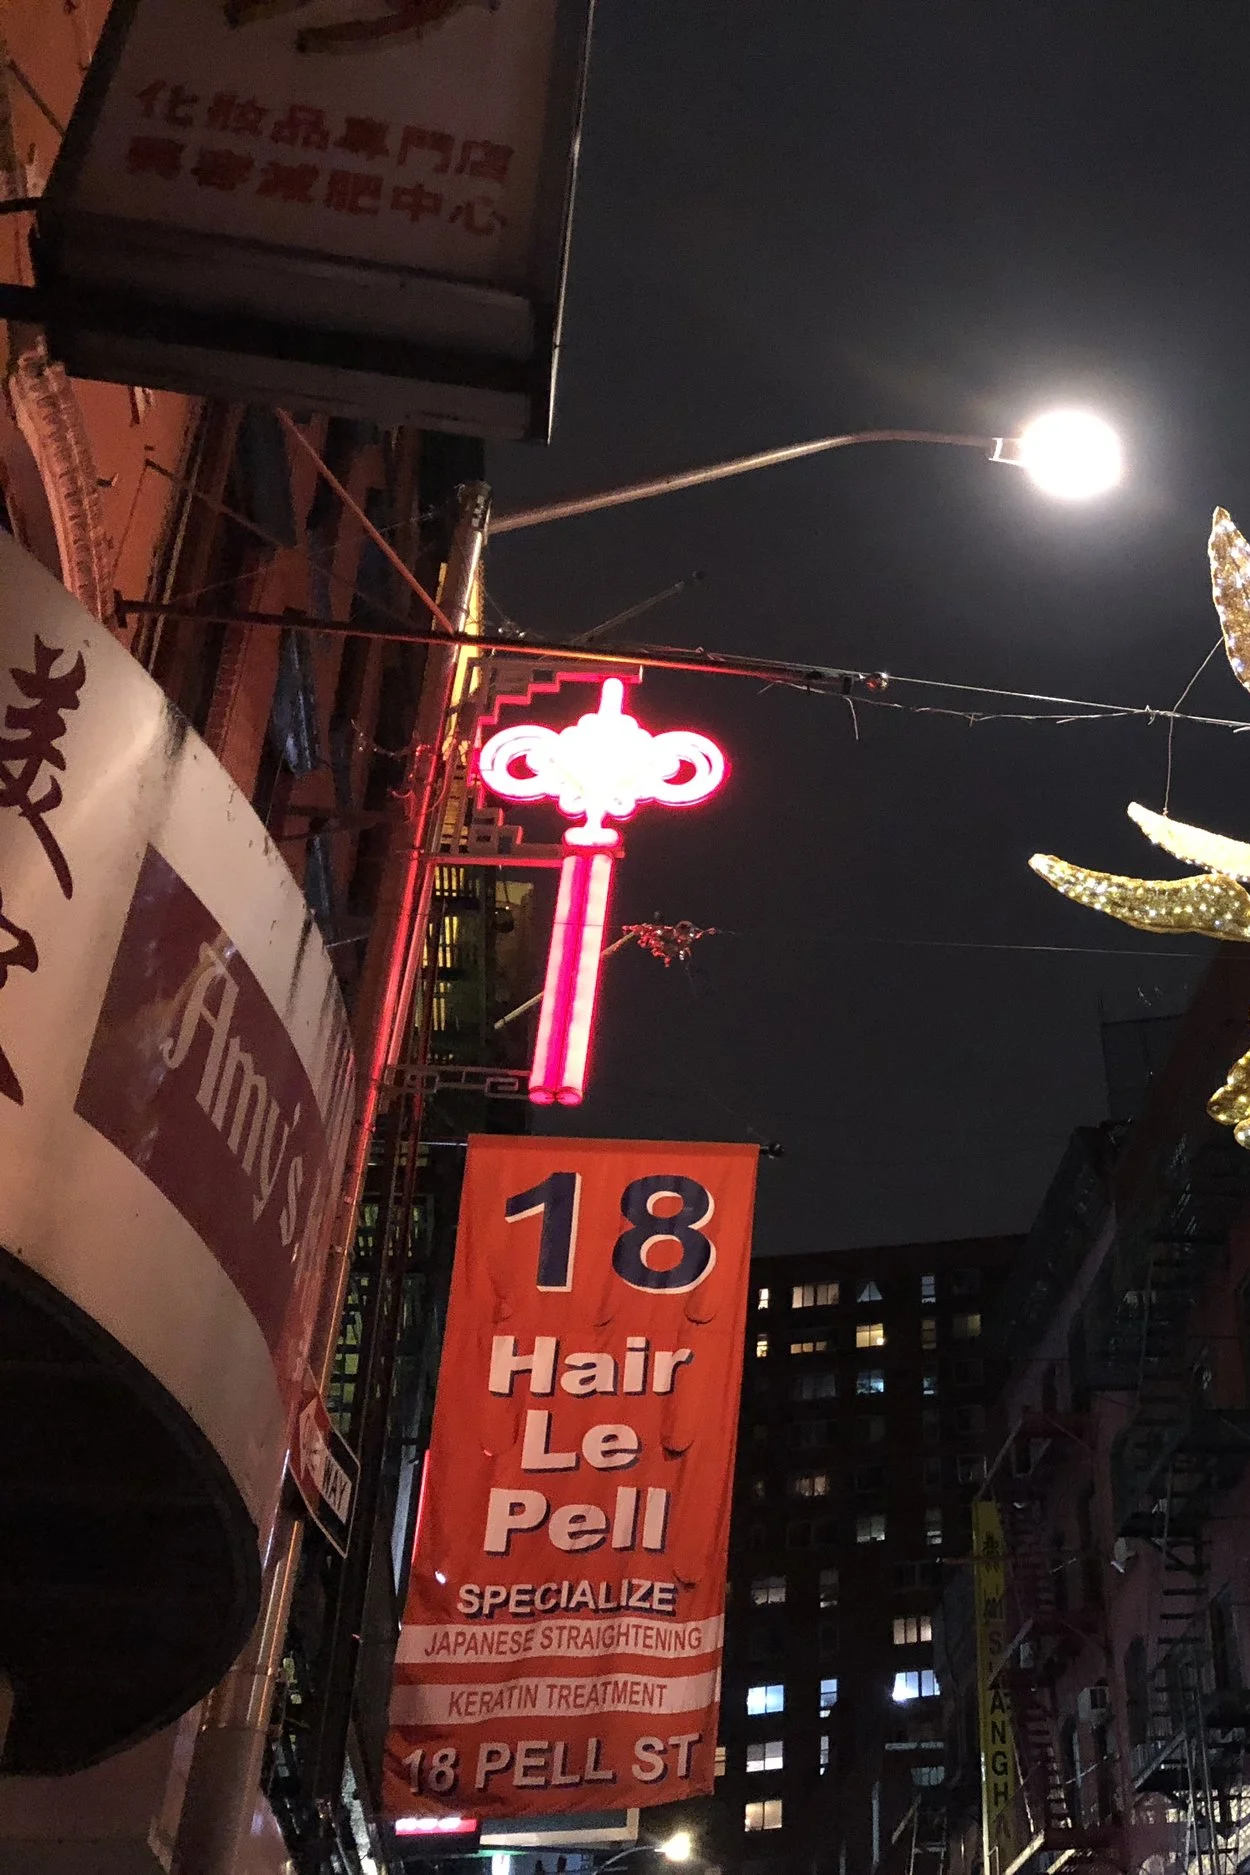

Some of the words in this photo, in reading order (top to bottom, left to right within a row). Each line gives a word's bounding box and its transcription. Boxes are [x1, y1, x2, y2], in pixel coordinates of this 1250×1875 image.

[160, 940, 304, 1246] Amy's
[505, 1171, 717, 1295] 18
[488, 1335, 694, 1397] Hair
[521, 1409, 641, 1474] Le
[484, 1486, 671, 1556] Pell
[457, 1578, 678, 1619] SPECIALIZE
[424, 1629, 534, 1657] JAPANESE
[540, 1623, 703, 1651] STRAIGHTENING
[447, 1684, 539, 1718] KERATIN
[546, 1682, 668, 1709] TREATMENT
[401, 1747, 459, 1796] 18
[474, 1738, 617, 1791] PELL
[631, 1732, 706, 1785] ST
